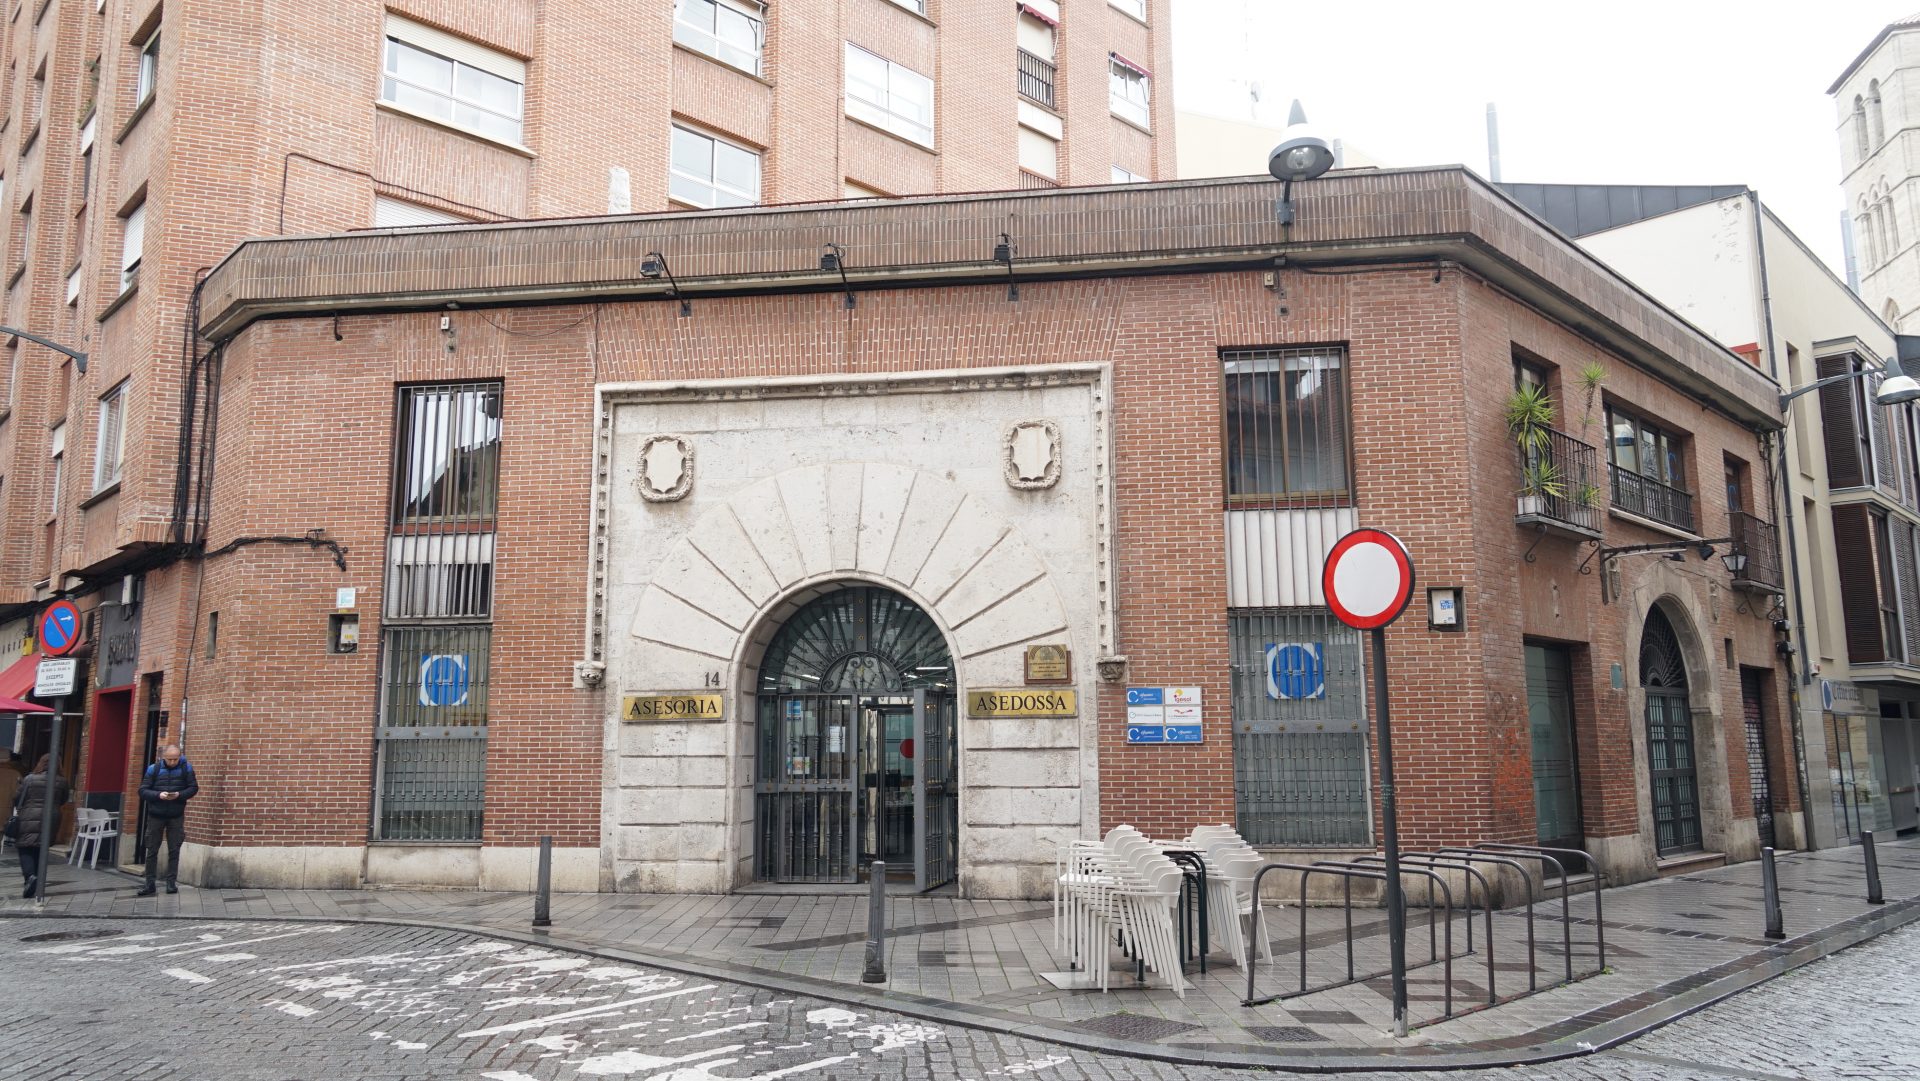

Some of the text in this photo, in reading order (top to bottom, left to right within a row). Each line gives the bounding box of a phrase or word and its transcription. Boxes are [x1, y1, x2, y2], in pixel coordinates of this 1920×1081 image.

[705, 671, 720, 687] 14
[629, 699, 718, 715] ASESORIA
[976, 695, 1067, 711] ASEDOSSA
